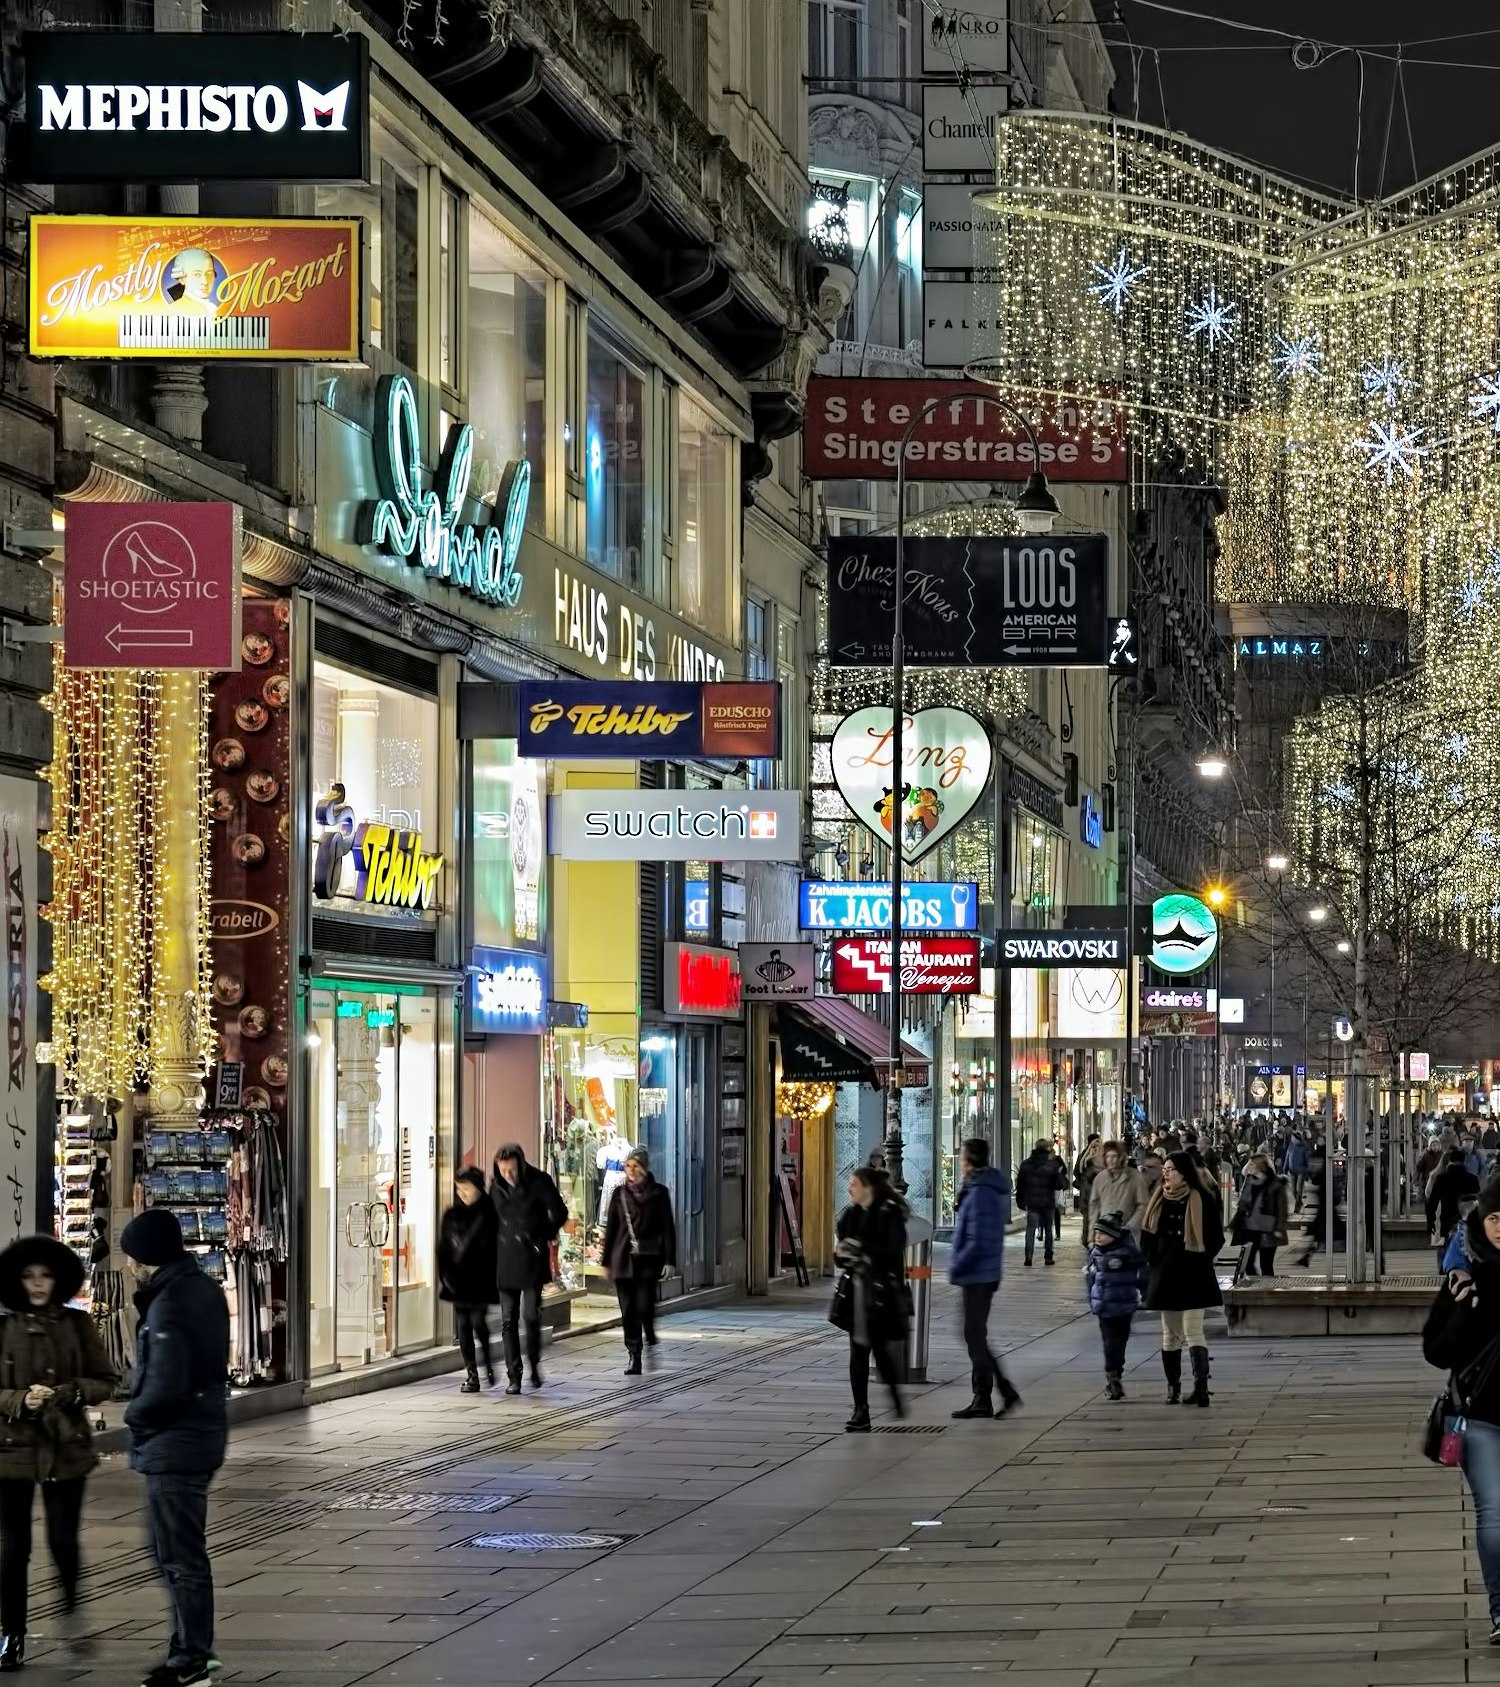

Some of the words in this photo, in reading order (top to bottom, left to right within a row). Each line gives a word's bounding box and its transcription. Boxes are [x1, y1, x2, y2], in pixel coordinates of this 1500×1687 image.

[37, 84, 289, 132] MEPHISTO
[928, 115, 996, 139] Chantell
[40, 242, 162, 327] Mostly
[214, 241, 349, 326] Mozart
[823, 432, 1079, 467] Singerstrasse
[1091, 437, 1113, 463] 5
[79, 580, 219, 600] SHOETASTIC
[837, 554, 898, 592] Chez
[893, 569, 959, 623] Nous
[1003, 548, 1077, 608] LOOS
[555, 567, 609, 666] HAUS
[620, 604, 657, 681] DES
[1002, 613, 1077, 626] AMERICAN
[1002, 627, 1077, 640] BAR
[1239, 641, 1322, 655] ALMAZ
[567, 702, 695, 736] Tchibo
[709, 706, 772, 719] EDUSCHO
[748, 722, 768, 730] Depot
[584, 804, 747, 839] swatch
[361, 823, 444, 910] Tchibo
[211, 910, 265, 928] rabell
[808, 898, 836, 927] K.
[840, 898, 943, 928] JACOBS
[1004, 939, 1119, 960] SWAROVSKI
[745, 984, 769, 994] Foot
[899, 965, 976, 993] Venezia
